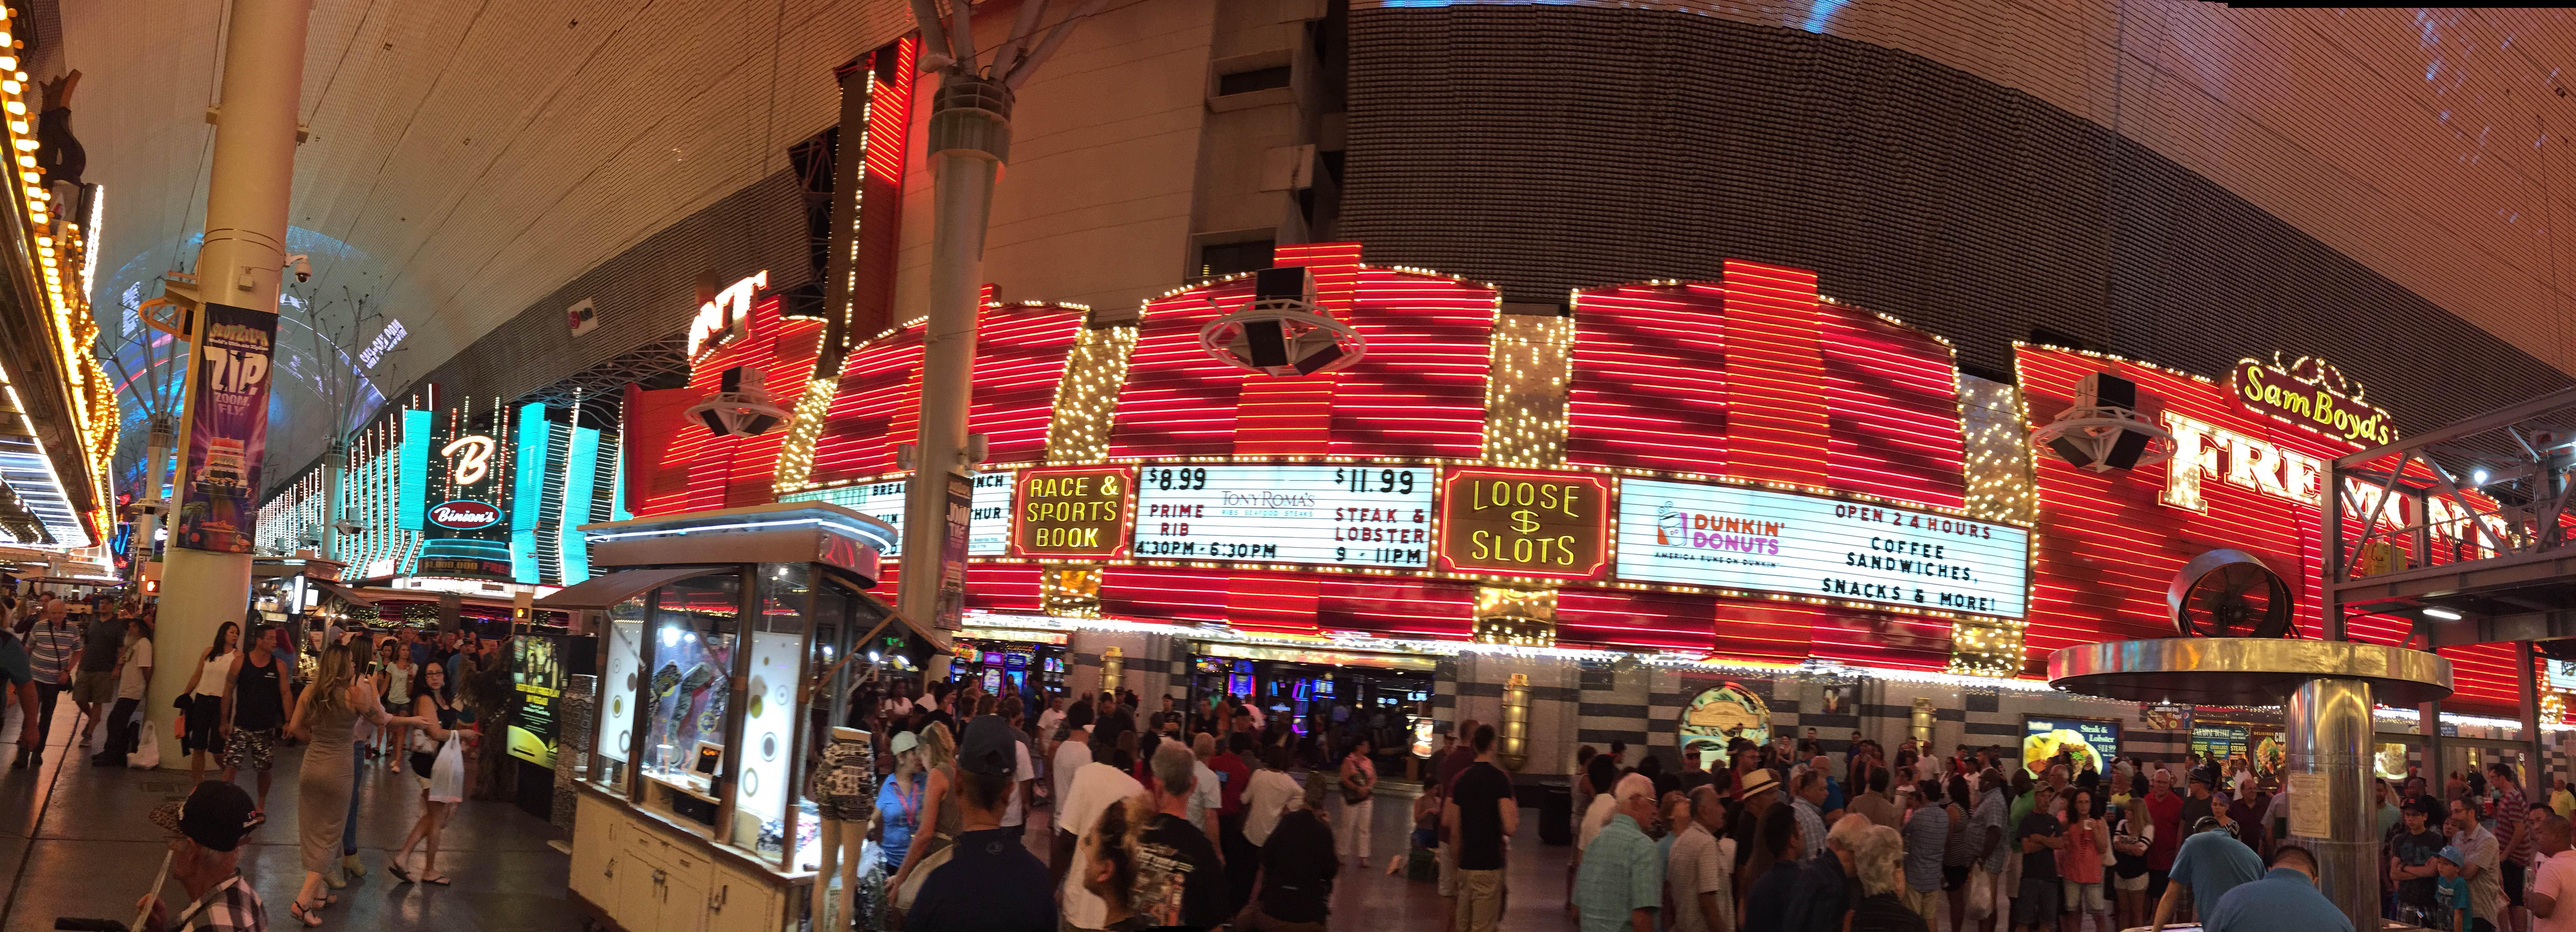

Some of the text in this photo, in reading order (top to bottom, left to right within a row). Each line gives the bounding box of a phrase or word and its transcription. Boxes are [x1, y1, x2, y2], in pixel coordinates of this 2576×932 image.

[208, 323, 269, 347] SLOTZILLA
[214, 391, 250, 406] ZOOM.
[2244, 365, 2389, 445] Sam Boyd's
[441, 435, 495, 485] B
[1030, 476, 1119, 497] RACE &
[1150, 468, 1413, 495] $8.99 $11.99
[1473, 480, 1580, 518] LOOSE
[434, 507, 495, 523] Binion's
[1027, 501, 1118, 522] SPORTS
[1150, 504, 1424, 523] PRIME STEAK &
[1510, 509, 1541, 535] $
[1836, 504, 1990, 539] OPEN 24 HOURS
[1160, 522, 1424, 543] RIB LOBSTER
[1695, 514, 1784, 537] DUNKIN'
[1036, 527, 1099, 548] BOOK
[1472, 530, 1575, 565] SLOTS
[1693, 532, 1779, 555] DONUTS
[1871, 536, 1944, 560] COFFEE
[1136, 541, 1195, 555] 4:30PM
[1210, 542, 1277, 558] 6:30PM
[1336, 546, 1346, 561] 9
[1376, 548, 1421, 563] 11PM
[1655, 552, 1695, 561] AMERICA
[1846, 551, 1978, 584] SANDWICHES,
[1822, 577, 1995, 611] SNACKS & MORE!
[2080, 724, 2101, 733] Steak
[2089, 734, 2115, 742] Lobster
